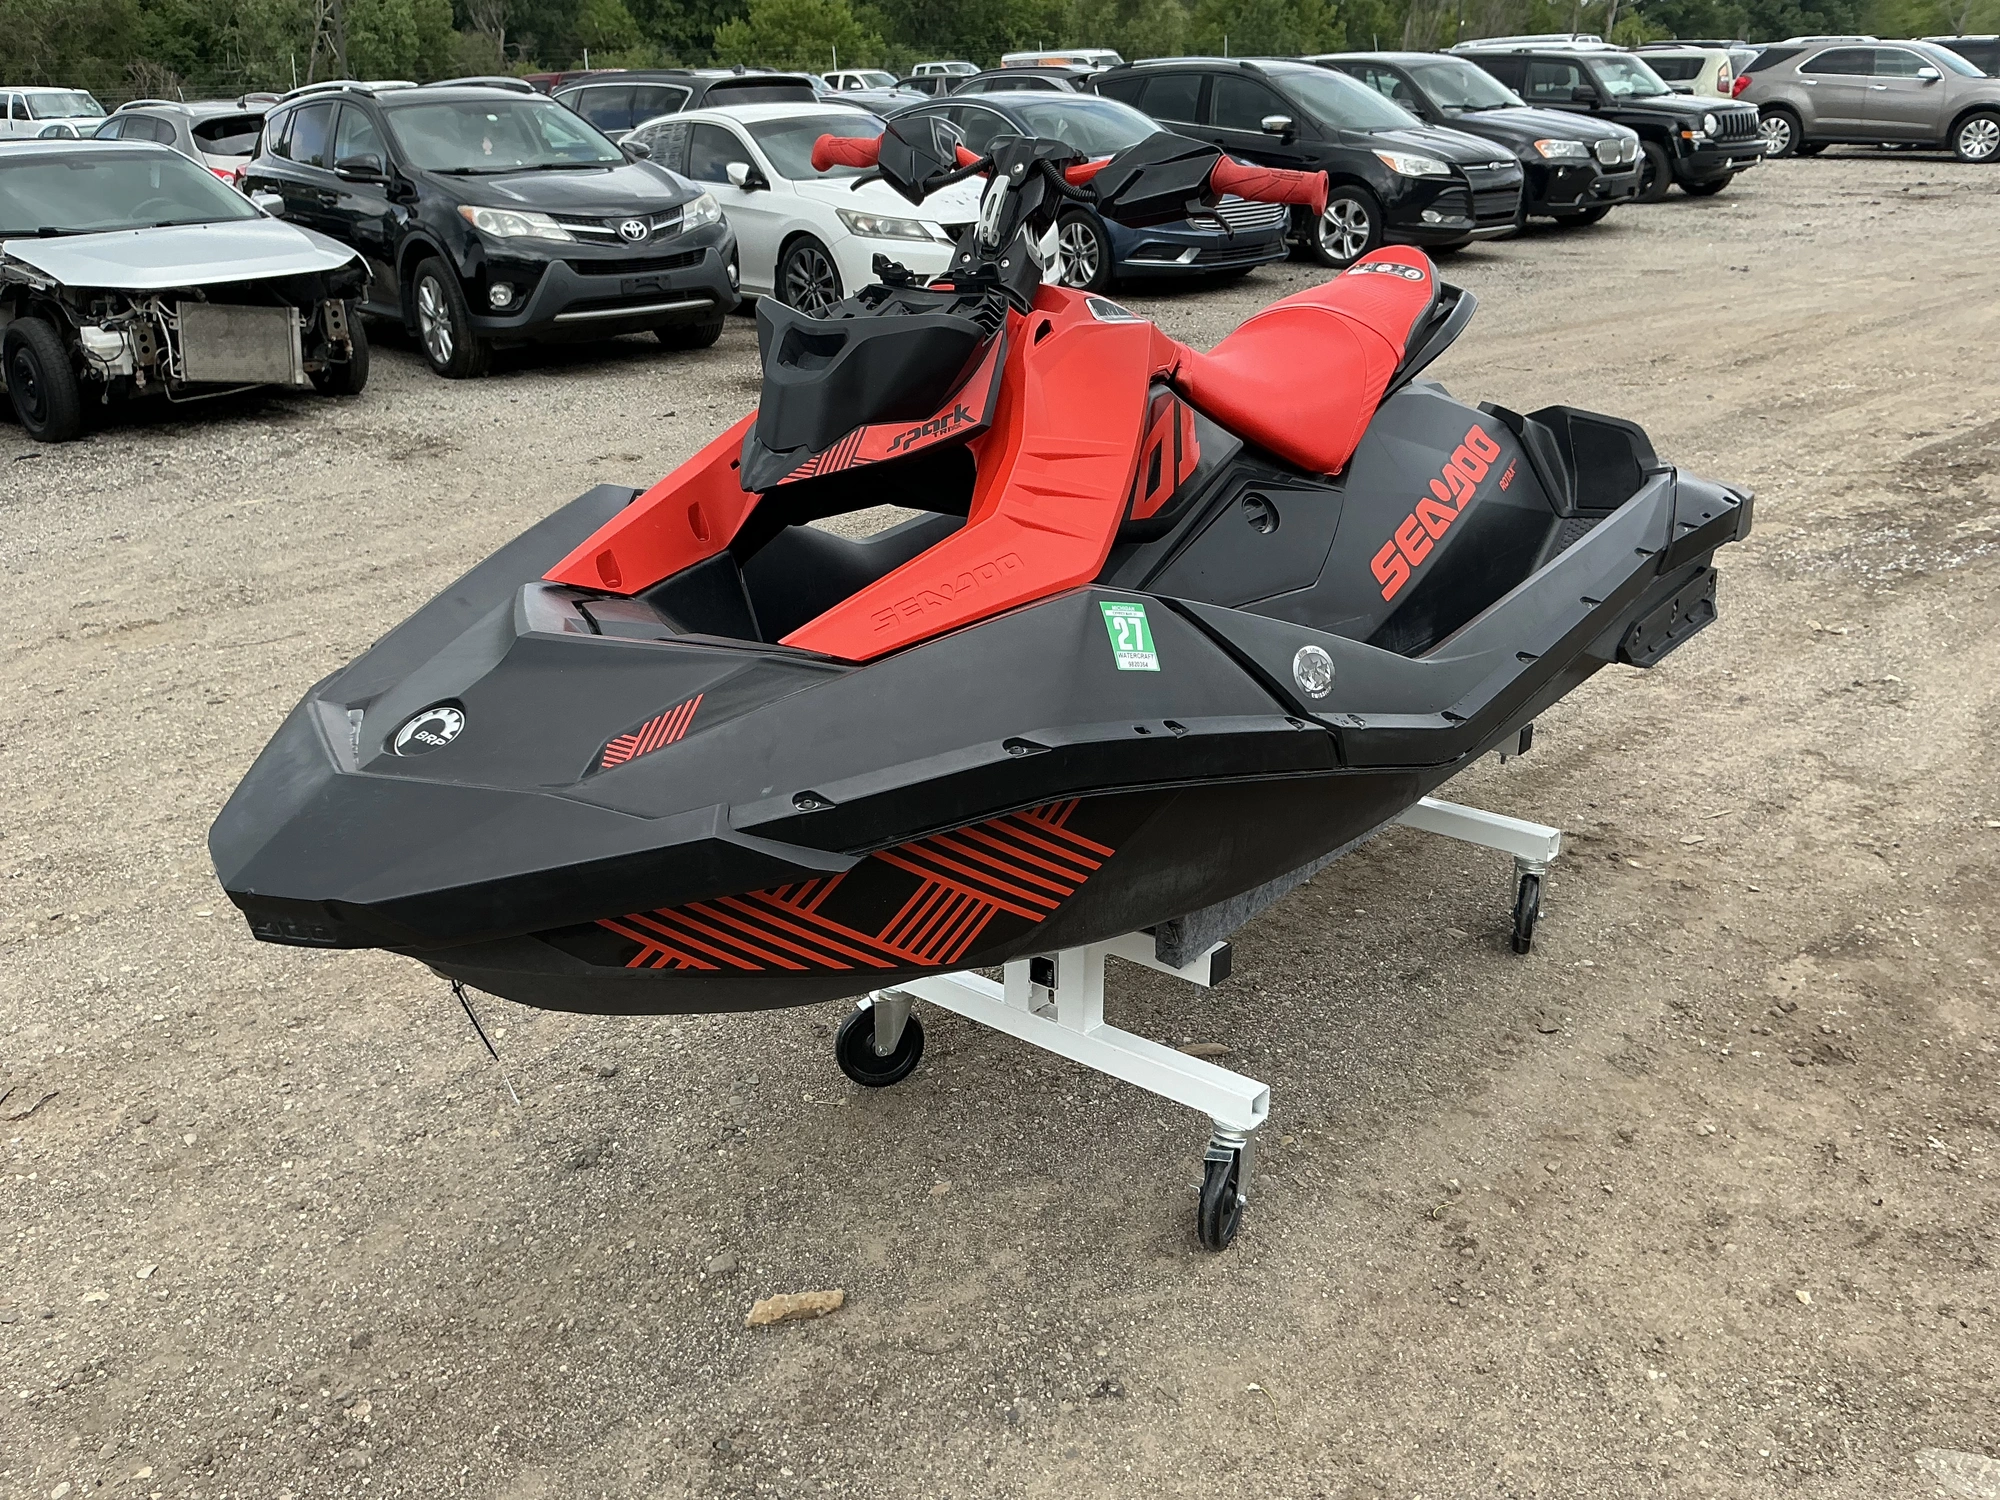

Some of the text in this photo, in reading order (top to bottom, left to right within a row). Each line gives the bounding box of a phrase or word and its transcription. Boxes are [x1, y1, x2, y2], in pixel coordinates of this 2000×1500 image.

[1499, 467, 1516, 492] ROTAX
[1113, 617, 1144, 651] 27
[1118, 652, 1154, 660] WATERCRAFT
[414, 730, 447, 746] BRP
